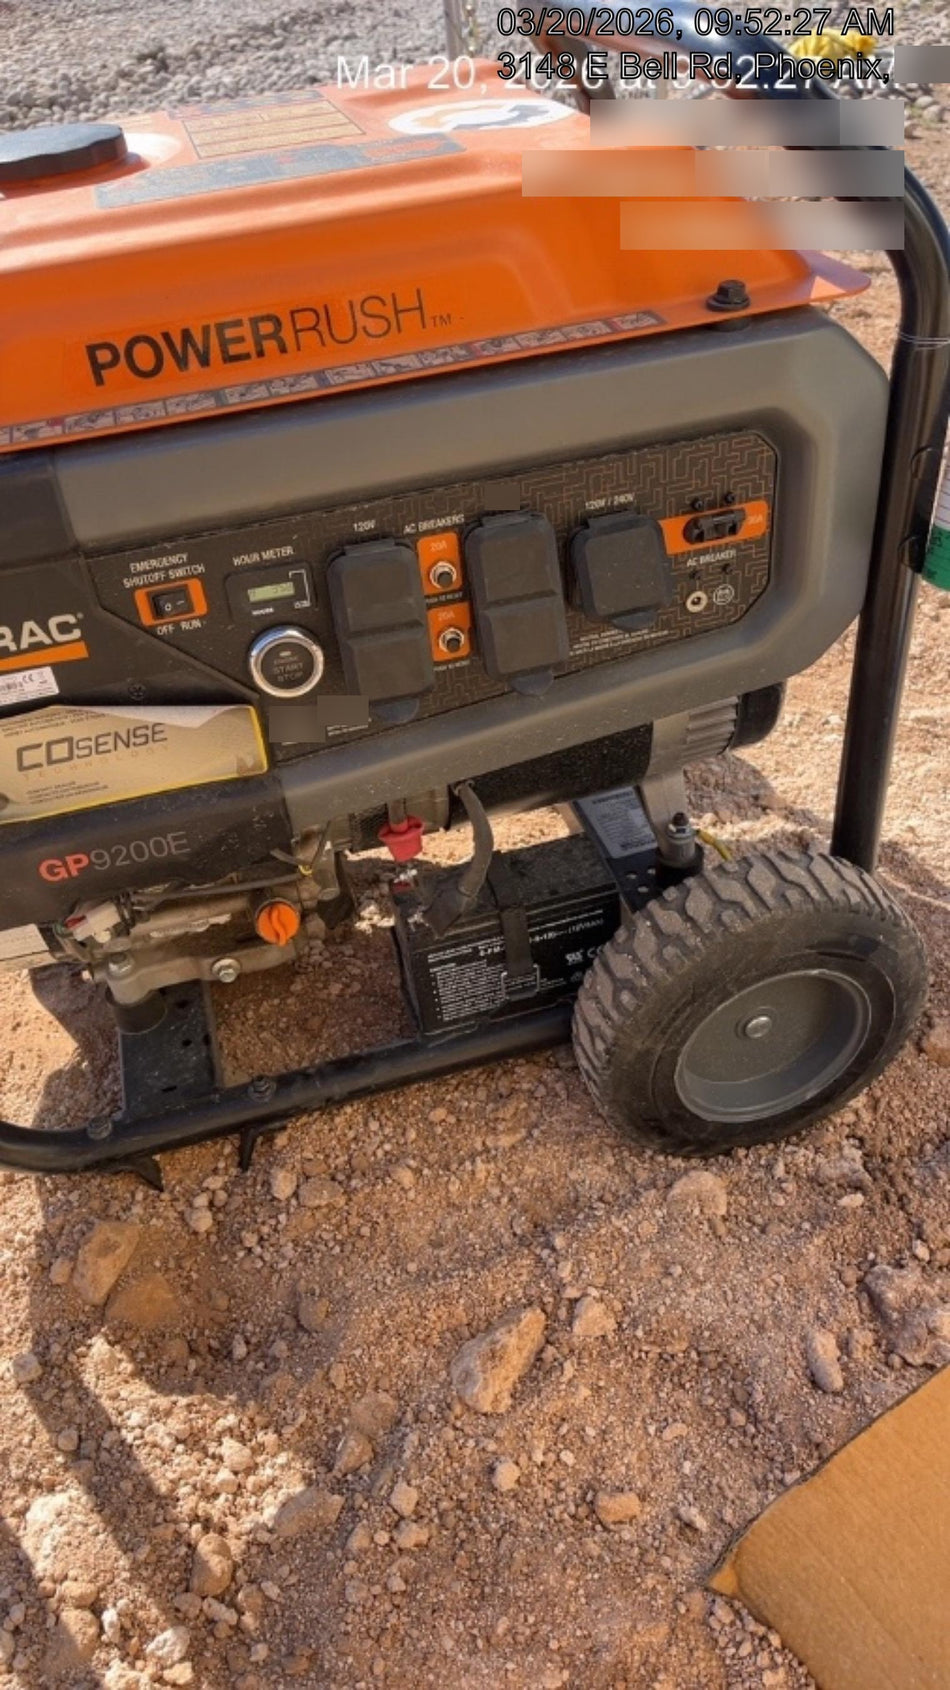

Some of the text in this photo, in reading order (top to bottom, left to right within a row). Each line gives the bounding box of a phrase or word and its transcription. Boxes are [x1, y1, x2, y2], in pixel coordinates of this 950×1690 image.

[86, 288, 427, 386] POWERRUSH
[130, 553, 188, 573] EMERGENCY
[232, 546, 294, 566] HOUR METER
[123, 564, 205, 589] SHUTOFF SWITCH
[157, 620, 201, 636] OFF RUN
[39, 831, 191, 881] GP9200E
